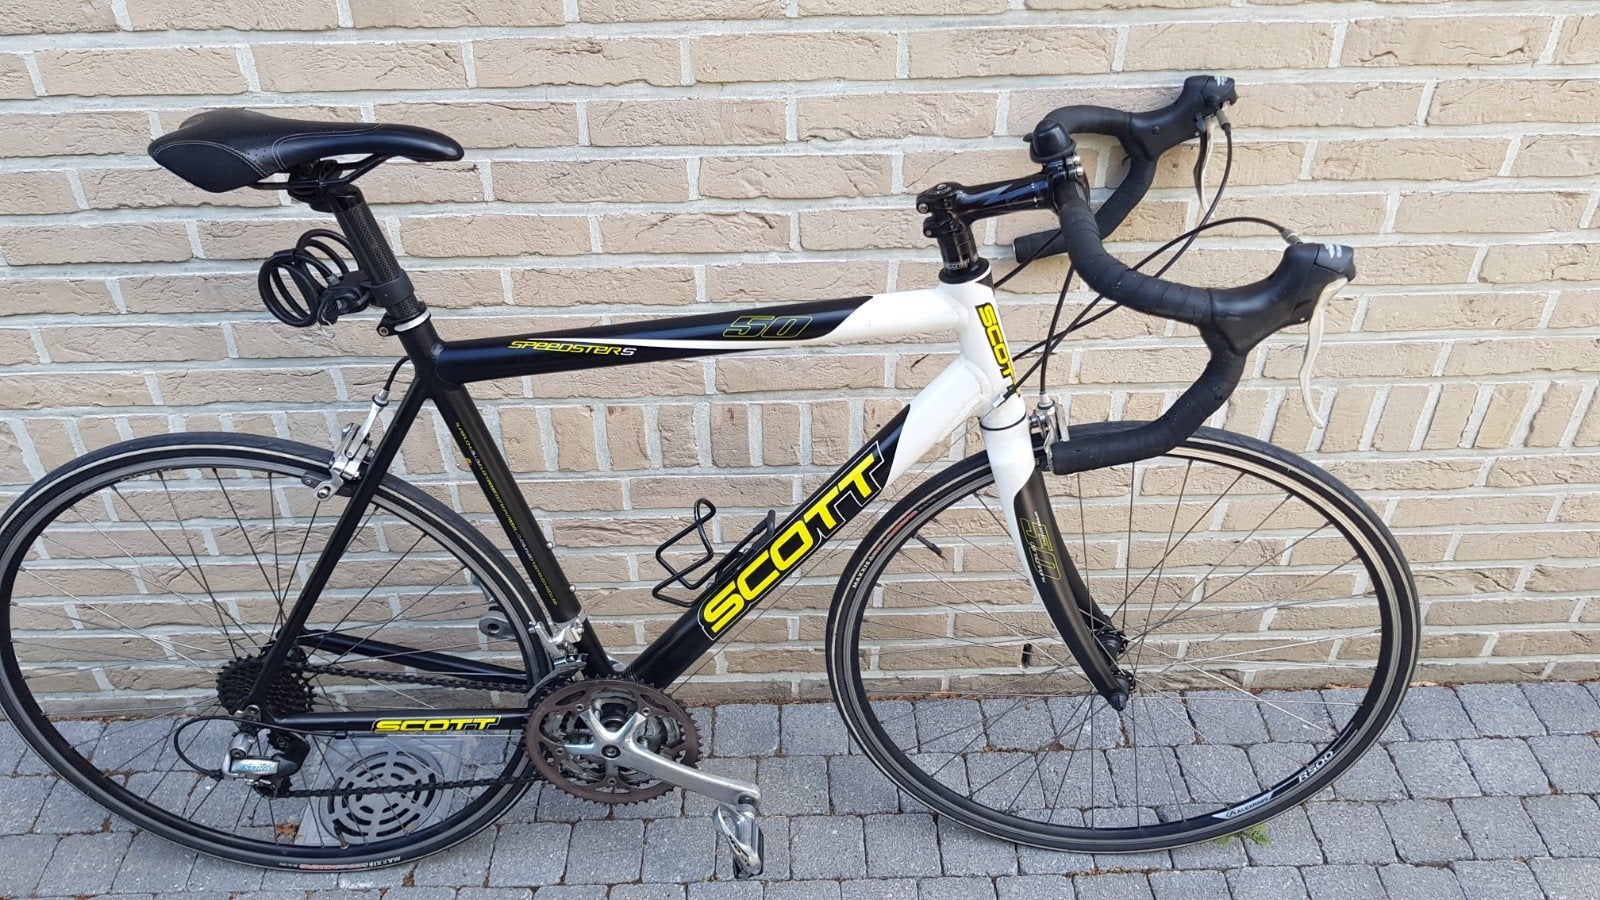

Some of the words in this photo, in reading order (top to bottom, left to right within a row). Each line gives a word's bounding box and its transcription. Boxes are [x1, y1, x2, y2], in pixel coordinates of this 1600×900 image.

[722, 315, 813, 338] 50
[703, 453, 875, 634] SCOTT
[852, 560, 870, 589] MAXXIS
[375, 717, 497, 732] SCOTT
[1299, 751, 1334, 783] R500
[369, 856, 401, 867] MAXXIS
